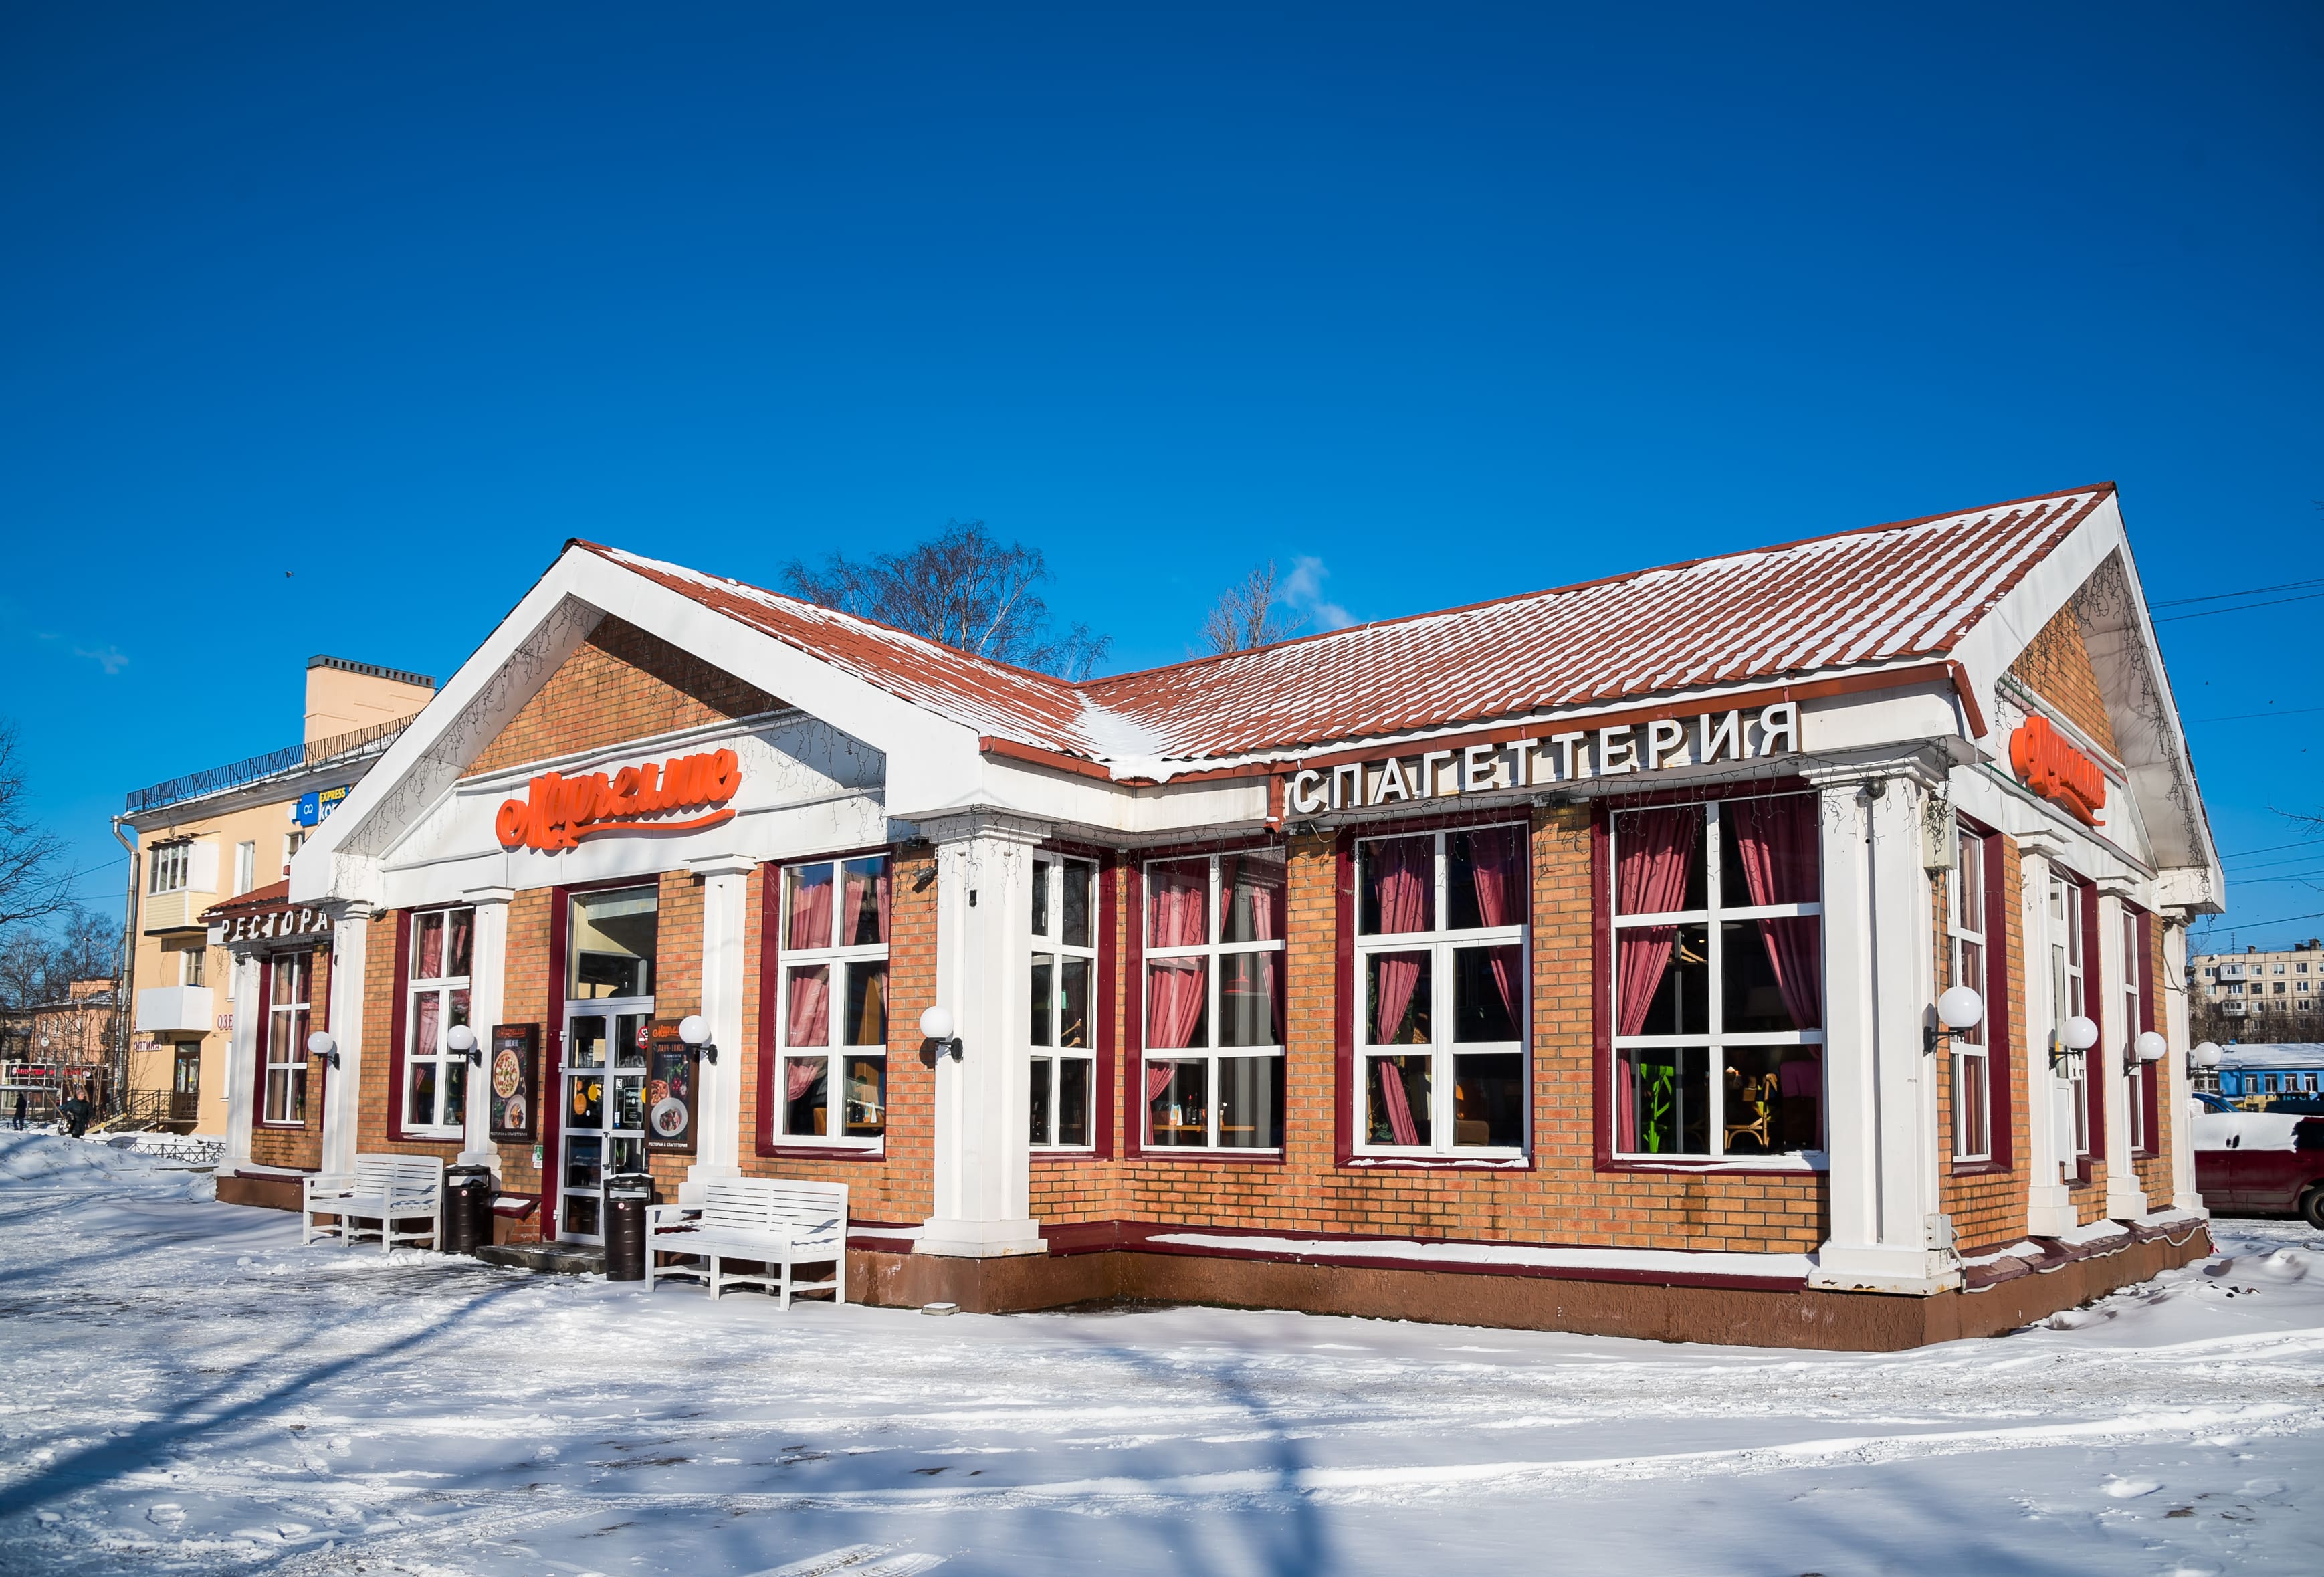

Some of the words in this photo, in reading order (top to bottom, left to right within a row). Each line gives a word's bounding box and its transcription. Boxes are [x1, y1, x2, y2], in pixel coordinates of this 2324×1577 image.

[1293, 702, 1802, 814] СПАГЕТТЕРИЯ
[319, 787, 346, 803] EXPRESS
[222, 908, 328, 942] РЕСТОРА
[134, 1041, 160, 1051] ОПТИКА
